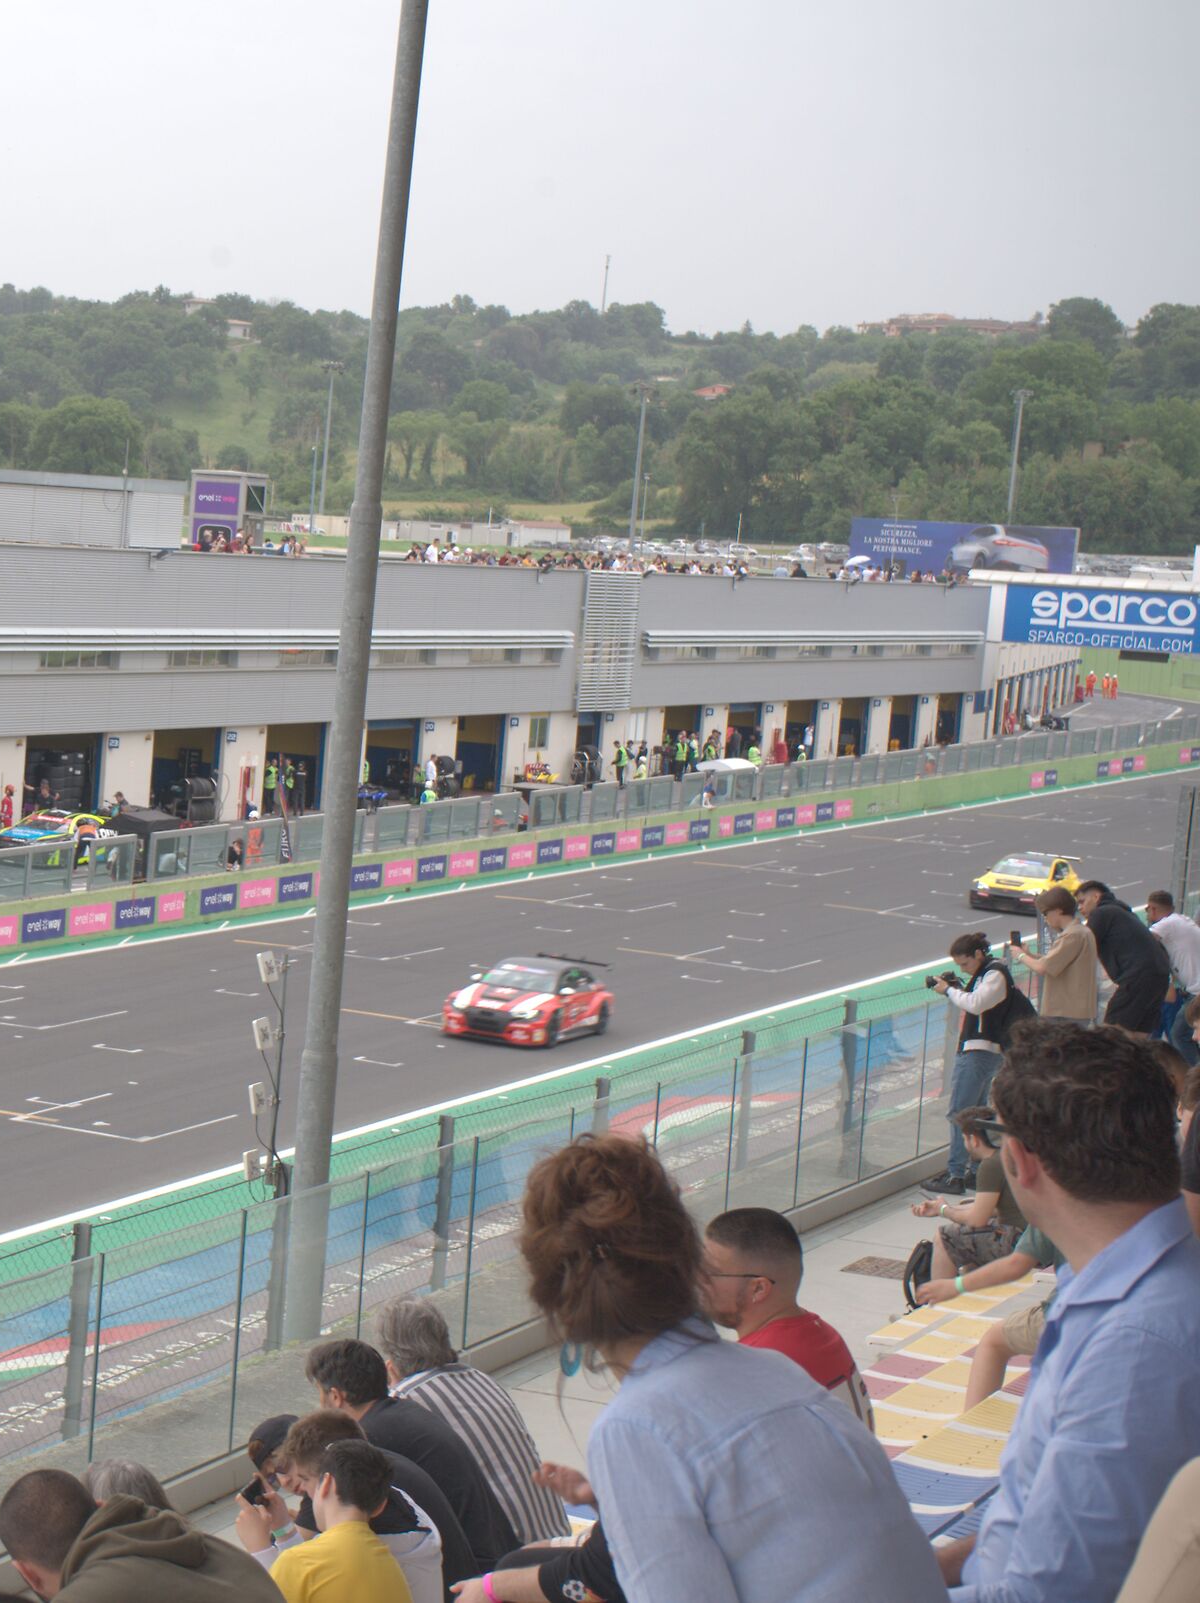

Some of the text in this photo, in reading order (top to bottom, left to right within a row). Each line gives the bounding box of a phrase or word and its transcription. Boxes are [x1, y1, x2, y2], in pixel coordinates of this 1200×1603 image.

[901, 538, 932, 547] MIGLIORE
[1031, 590, 1197, 629] sparco
[1028, 629, 1193, 652] SPARCO-OFFICIAL.COM
[0, 925, 13, 938] way
[27, 918, 62, 933] enel way
